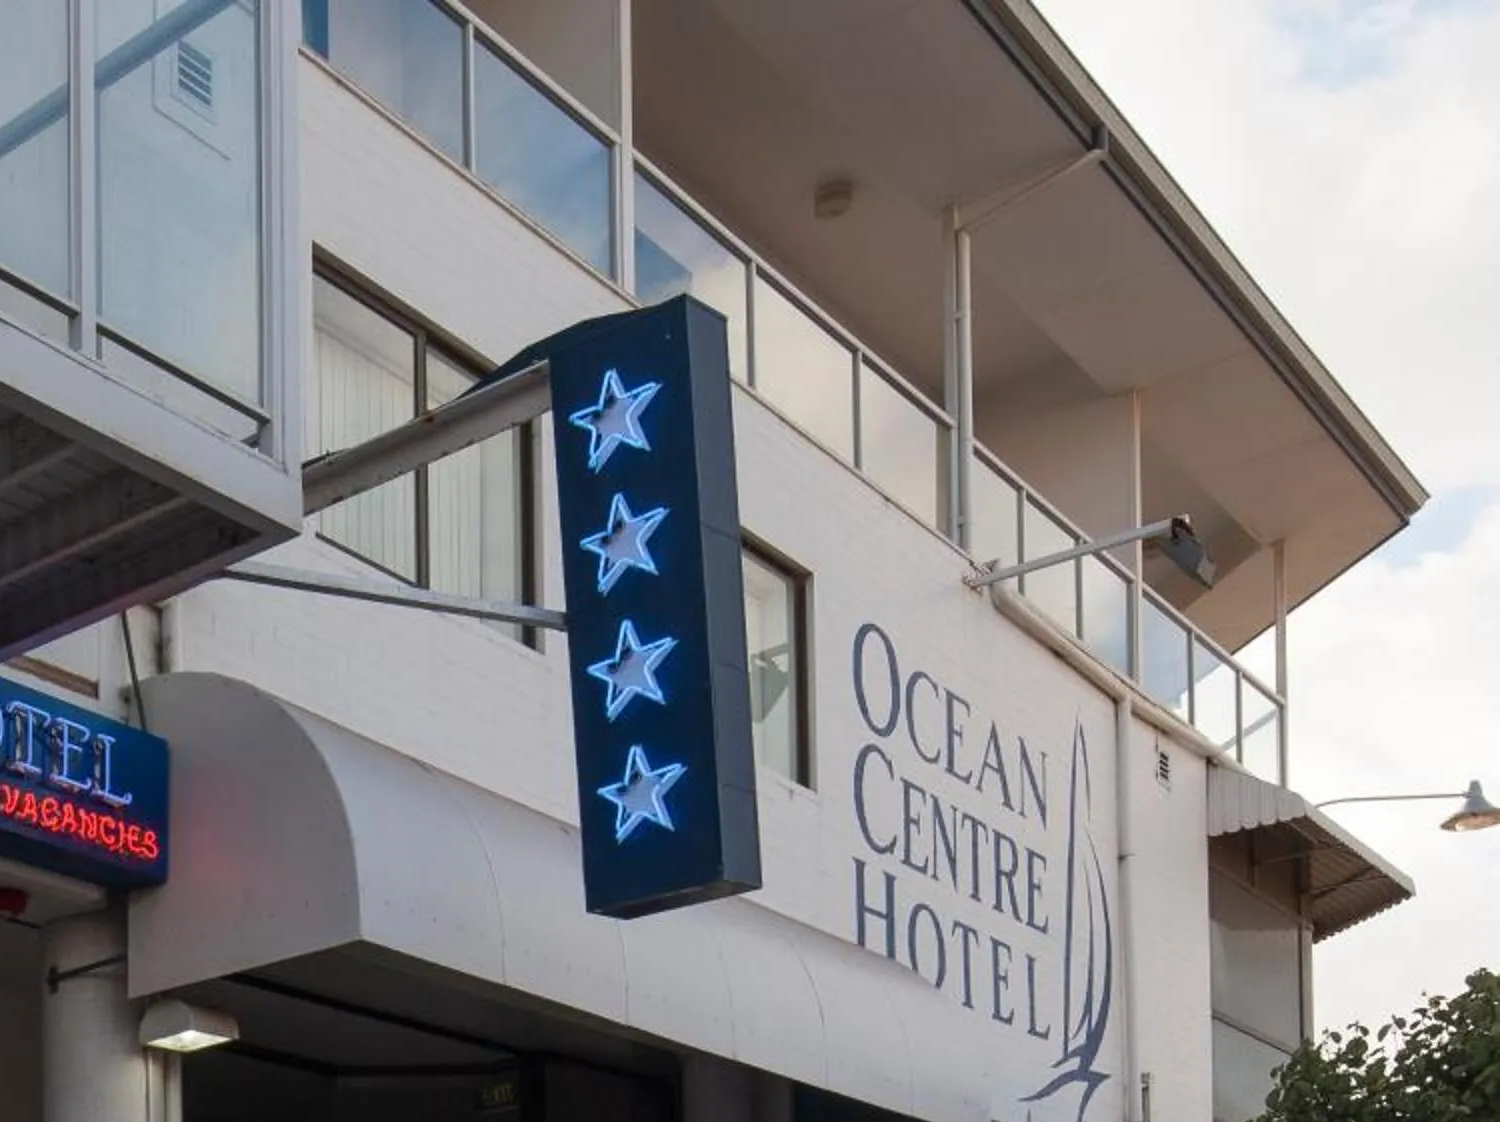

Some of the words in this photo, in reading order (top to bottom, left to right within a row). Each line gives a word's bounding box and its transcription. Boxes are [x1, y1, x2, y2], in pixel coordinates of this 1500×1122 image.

[852, 622, 1048, 833] OCEAN
[853, 743, 1049, 935] CENTRE
[852, 856, 1051, 1041] HOTEL
